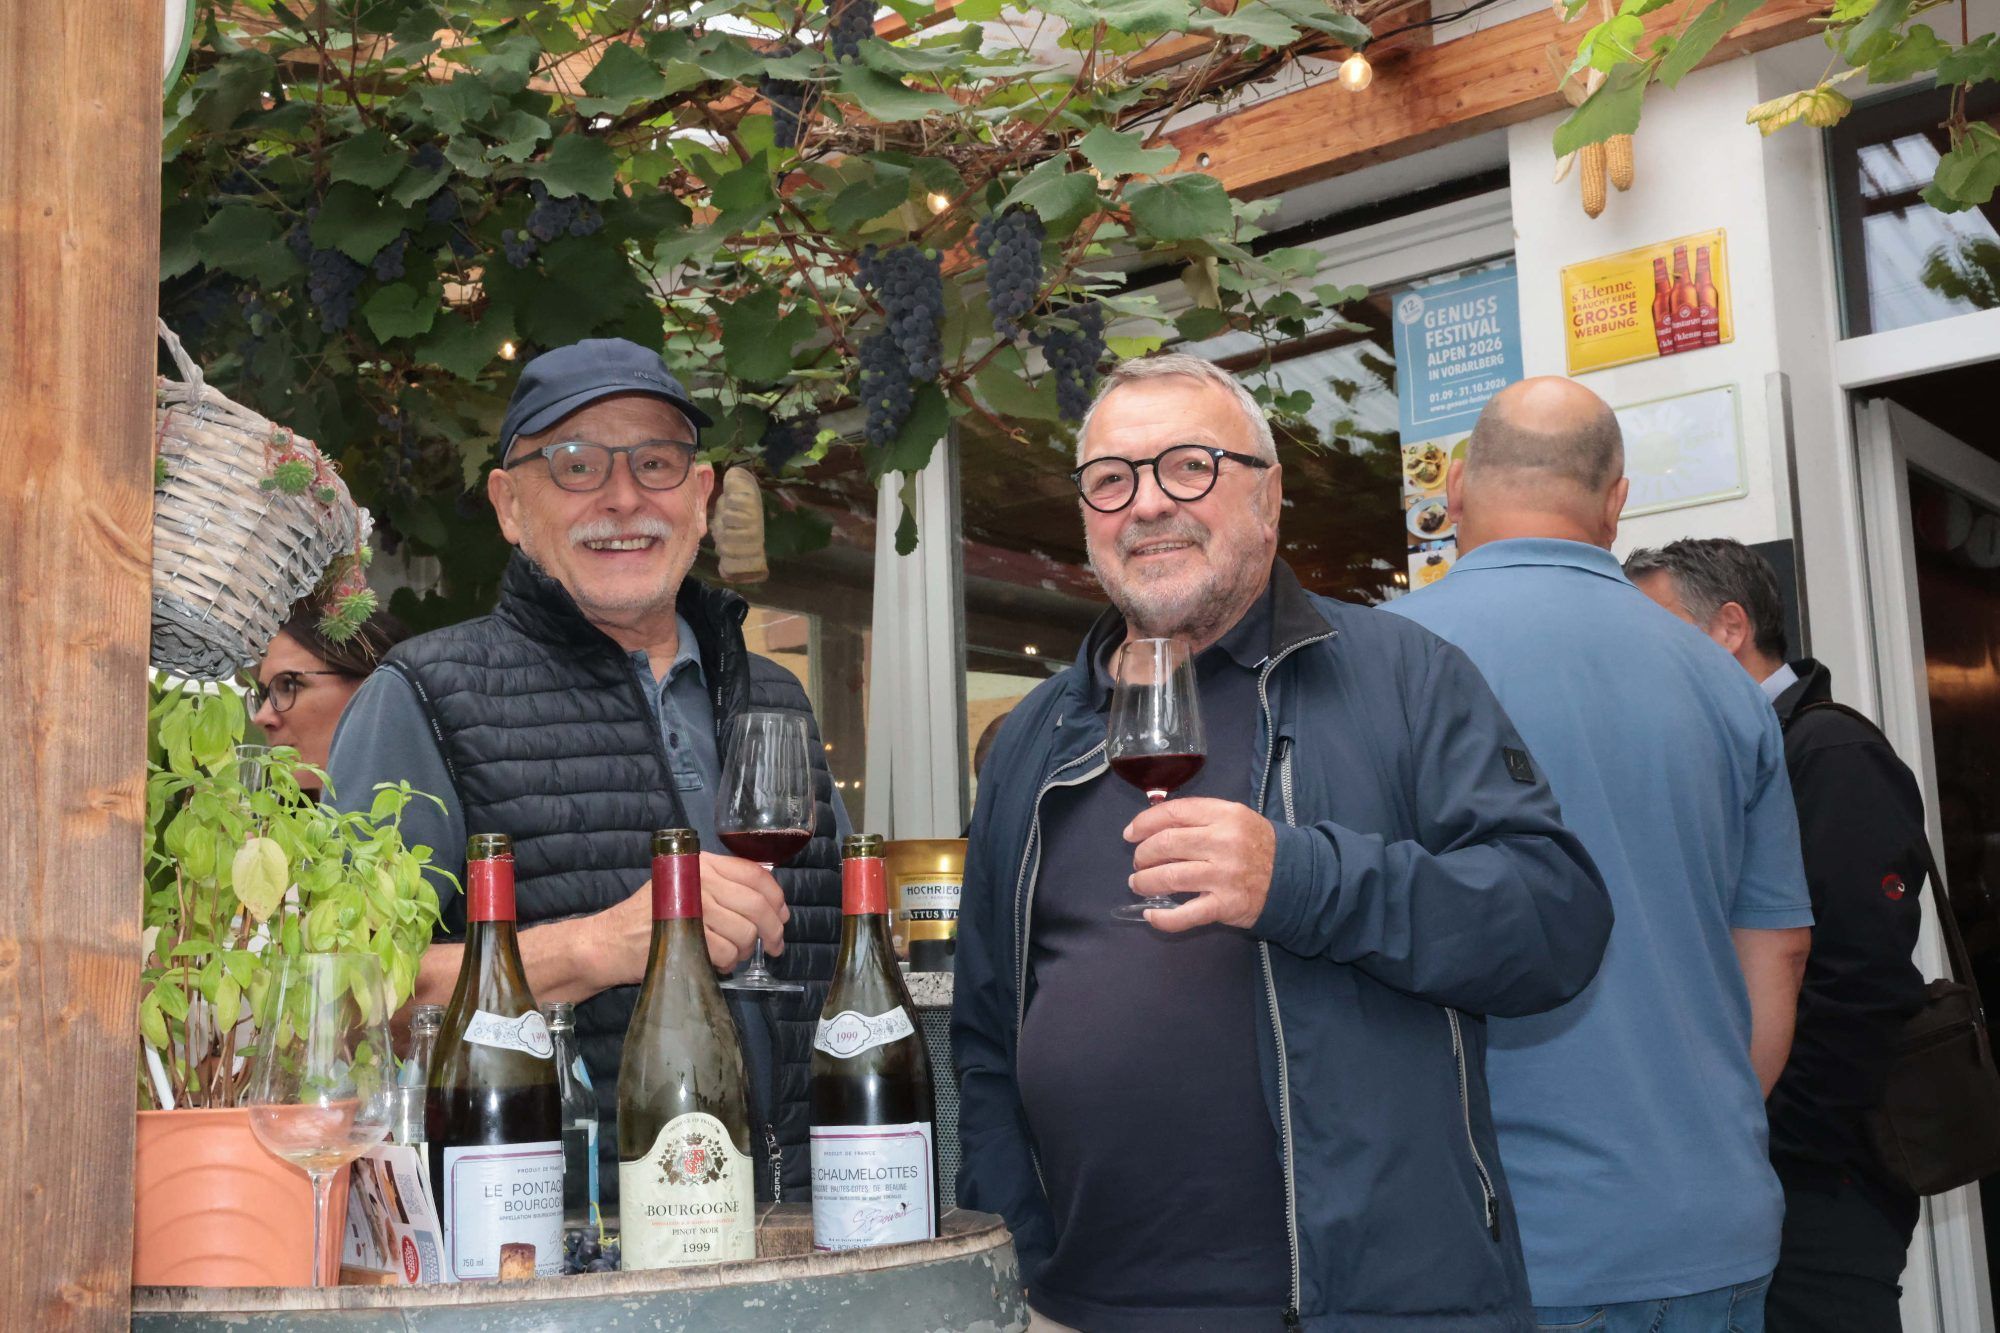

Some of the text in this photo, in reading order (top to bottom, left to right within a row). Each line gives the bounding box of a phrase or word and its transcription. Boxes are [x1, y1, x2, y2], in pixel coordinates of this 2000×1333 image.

[1424, 295, 1498, 328] GENUSS
[1572, 291, 1637, 313] BRAUCHT KEINE
[1573, 300, 1638, 327] GROSSE
[1425, 316, 1501, 350] FESTIVAL
[1574, 317, 1639, 339] WERBUNG.
[1427, 336, 1503, 367] ALPEN 2026
[1428, 353, 1505, 381] IN VORARLBERG
[836, 1031, 858, 1043] 1999
[818, 1165, 918, 1181] CHAUMELOTTES
[484, 1184, 503, 1198] LE
[647, 1200, 740, 1217] BOURGOGNE
[672, 1228, 697, 1236] PINOT
[682, 1242, 711, 1253] 1999
